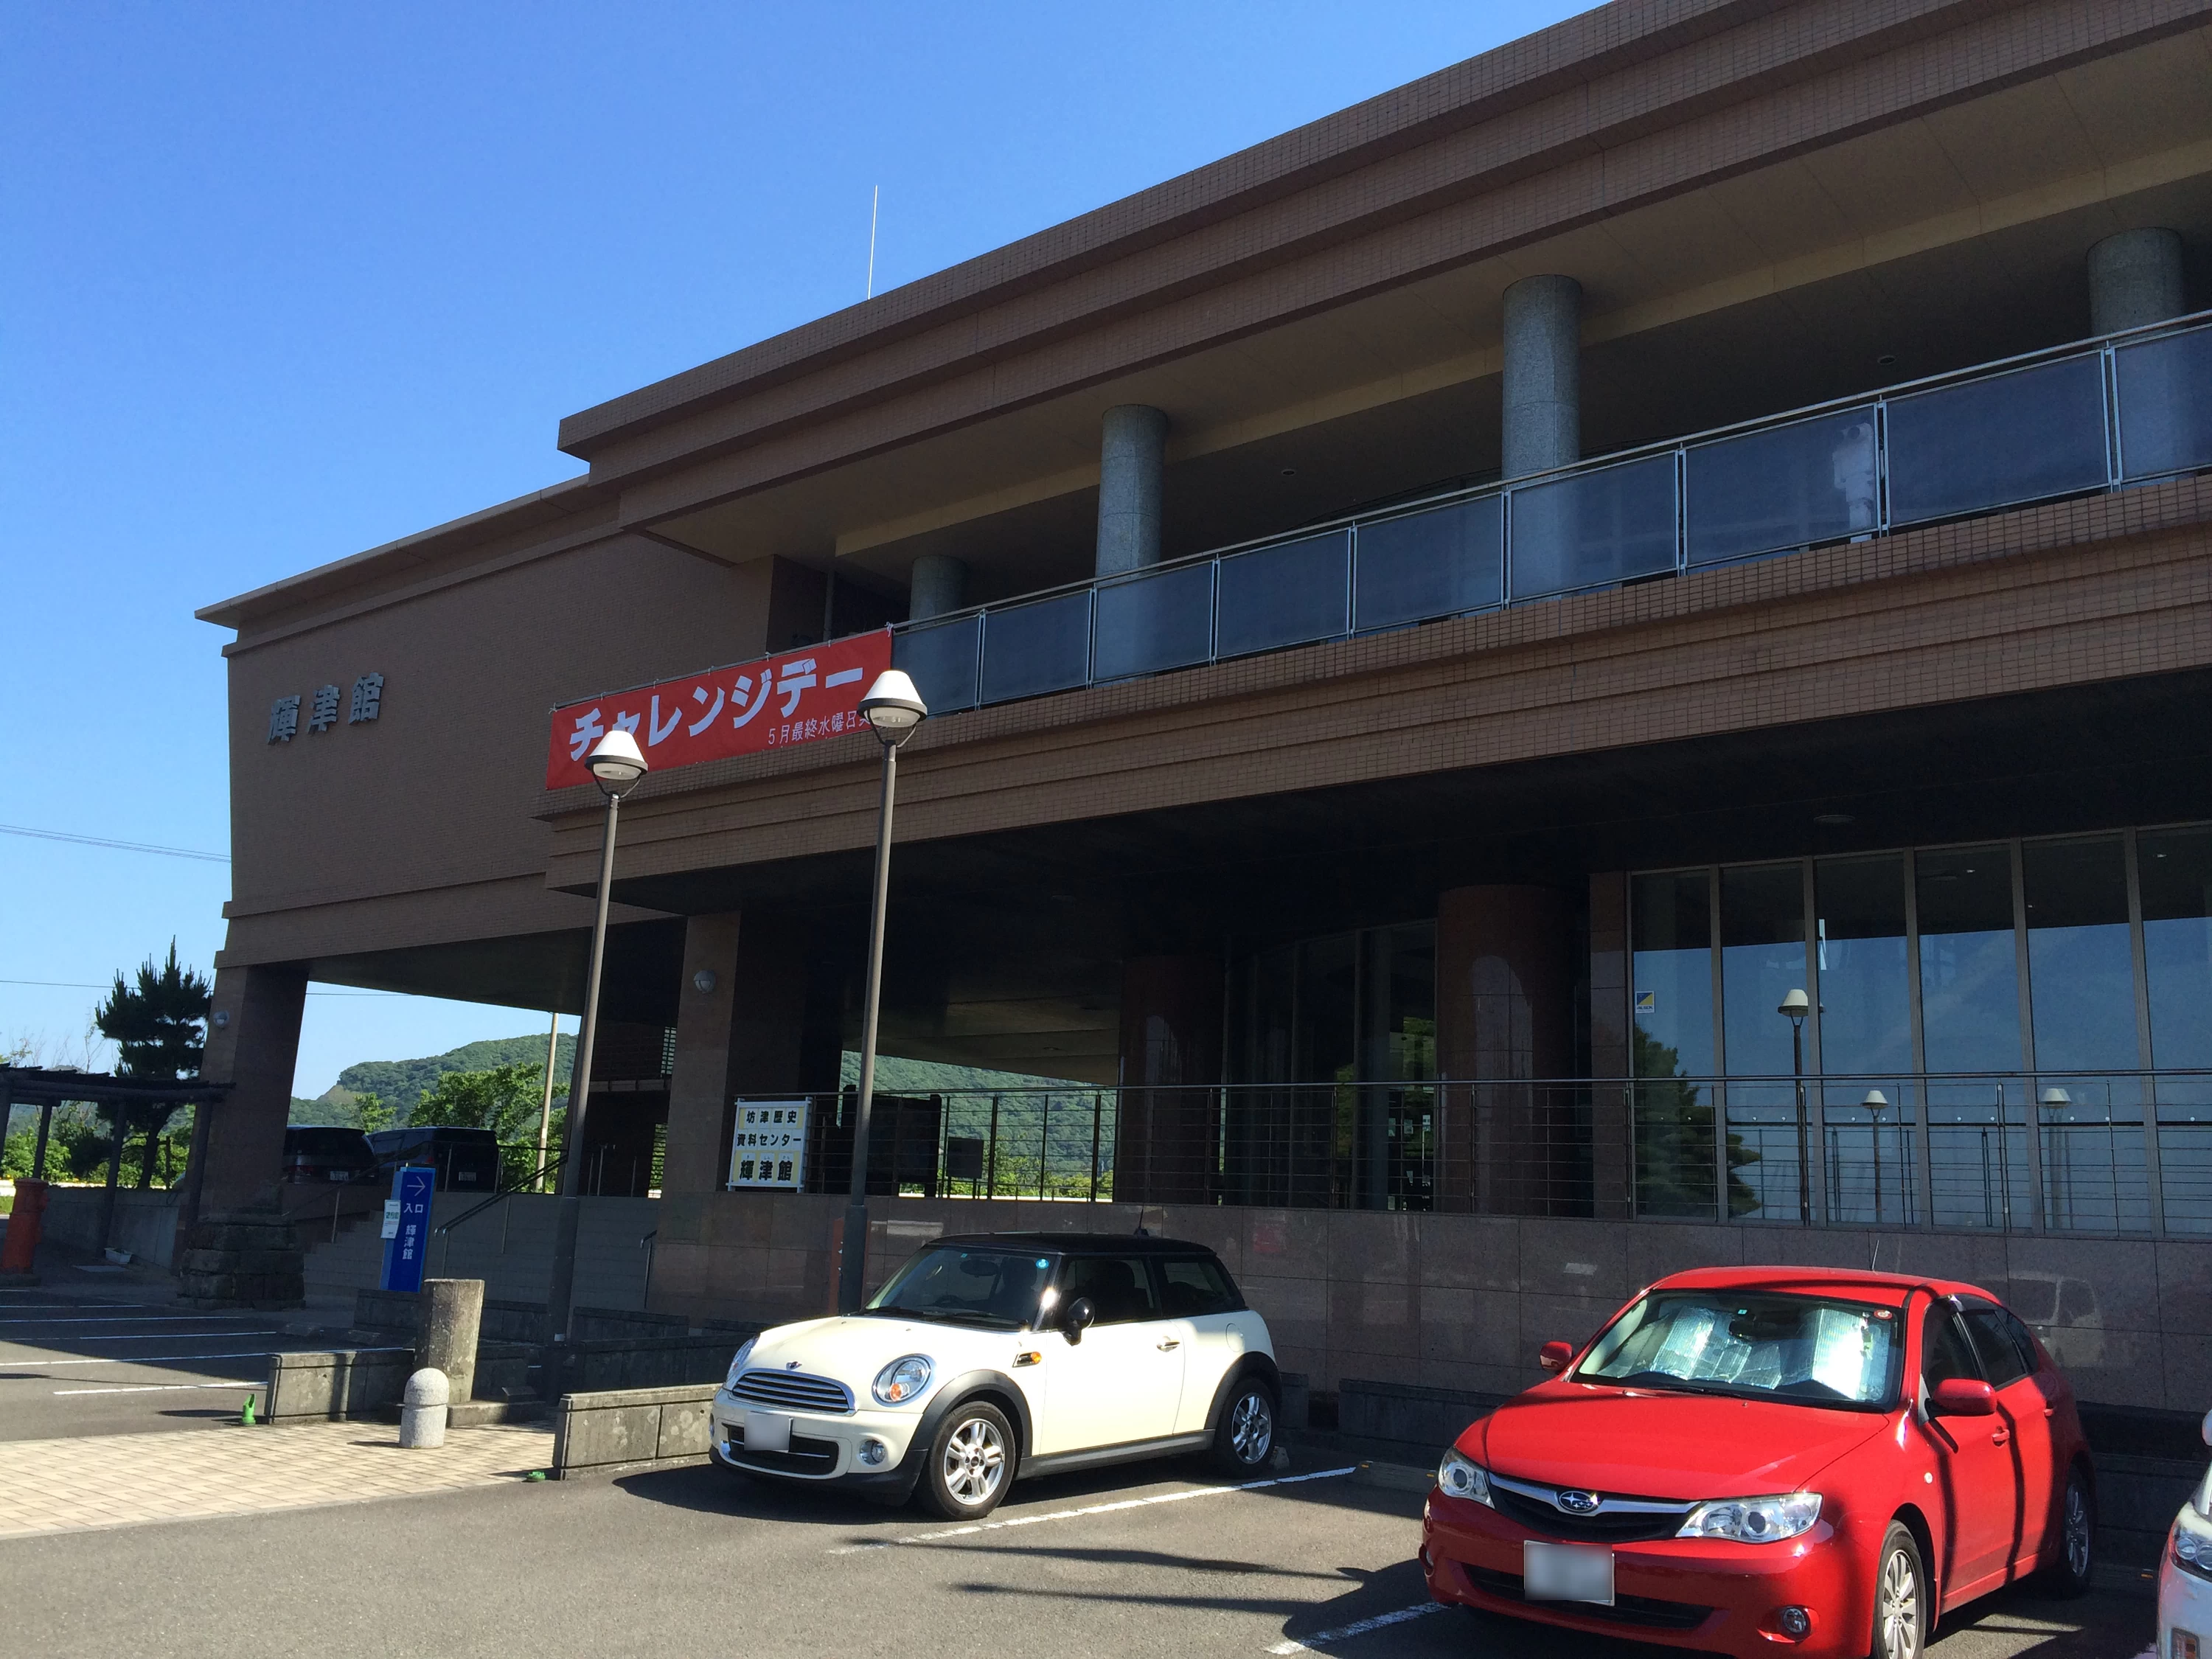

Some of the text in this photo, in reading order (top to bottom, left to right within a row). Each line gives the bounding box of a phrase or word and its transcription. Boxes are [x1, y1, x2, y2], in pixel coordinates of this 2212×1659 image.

[569, 658, 863, 761] チャレンジデー
[737, 1133, 801, 1147] 資料センター
[740, 1160, 793, 1181] 輝津館
[403, 1203, 424, 1214] 入口
[402, 1224, 417, 1259] 輝津館
